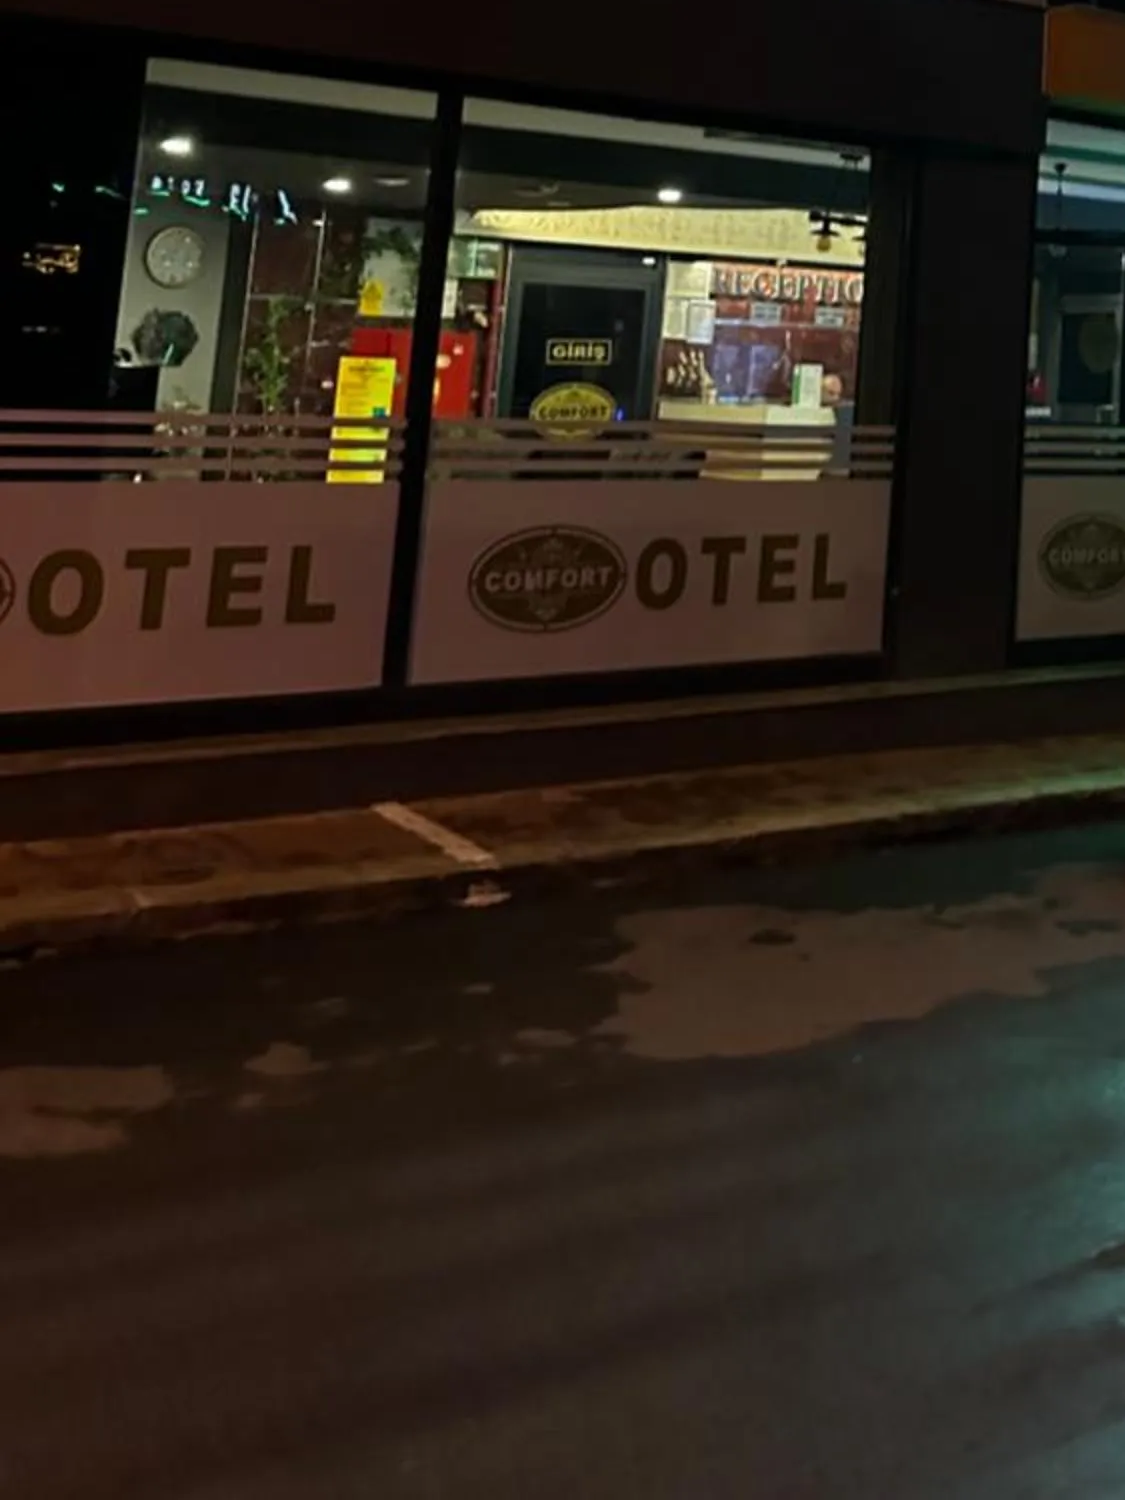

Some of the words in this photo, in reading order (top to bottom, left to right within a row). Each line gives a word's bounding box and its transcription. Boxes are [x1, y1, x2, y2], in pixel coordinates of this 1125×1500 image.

[28, 545, 336, 635] OTEL
[484, 564, 613, 594] COMFORT
[635, 533, 848, 610] OTEL
